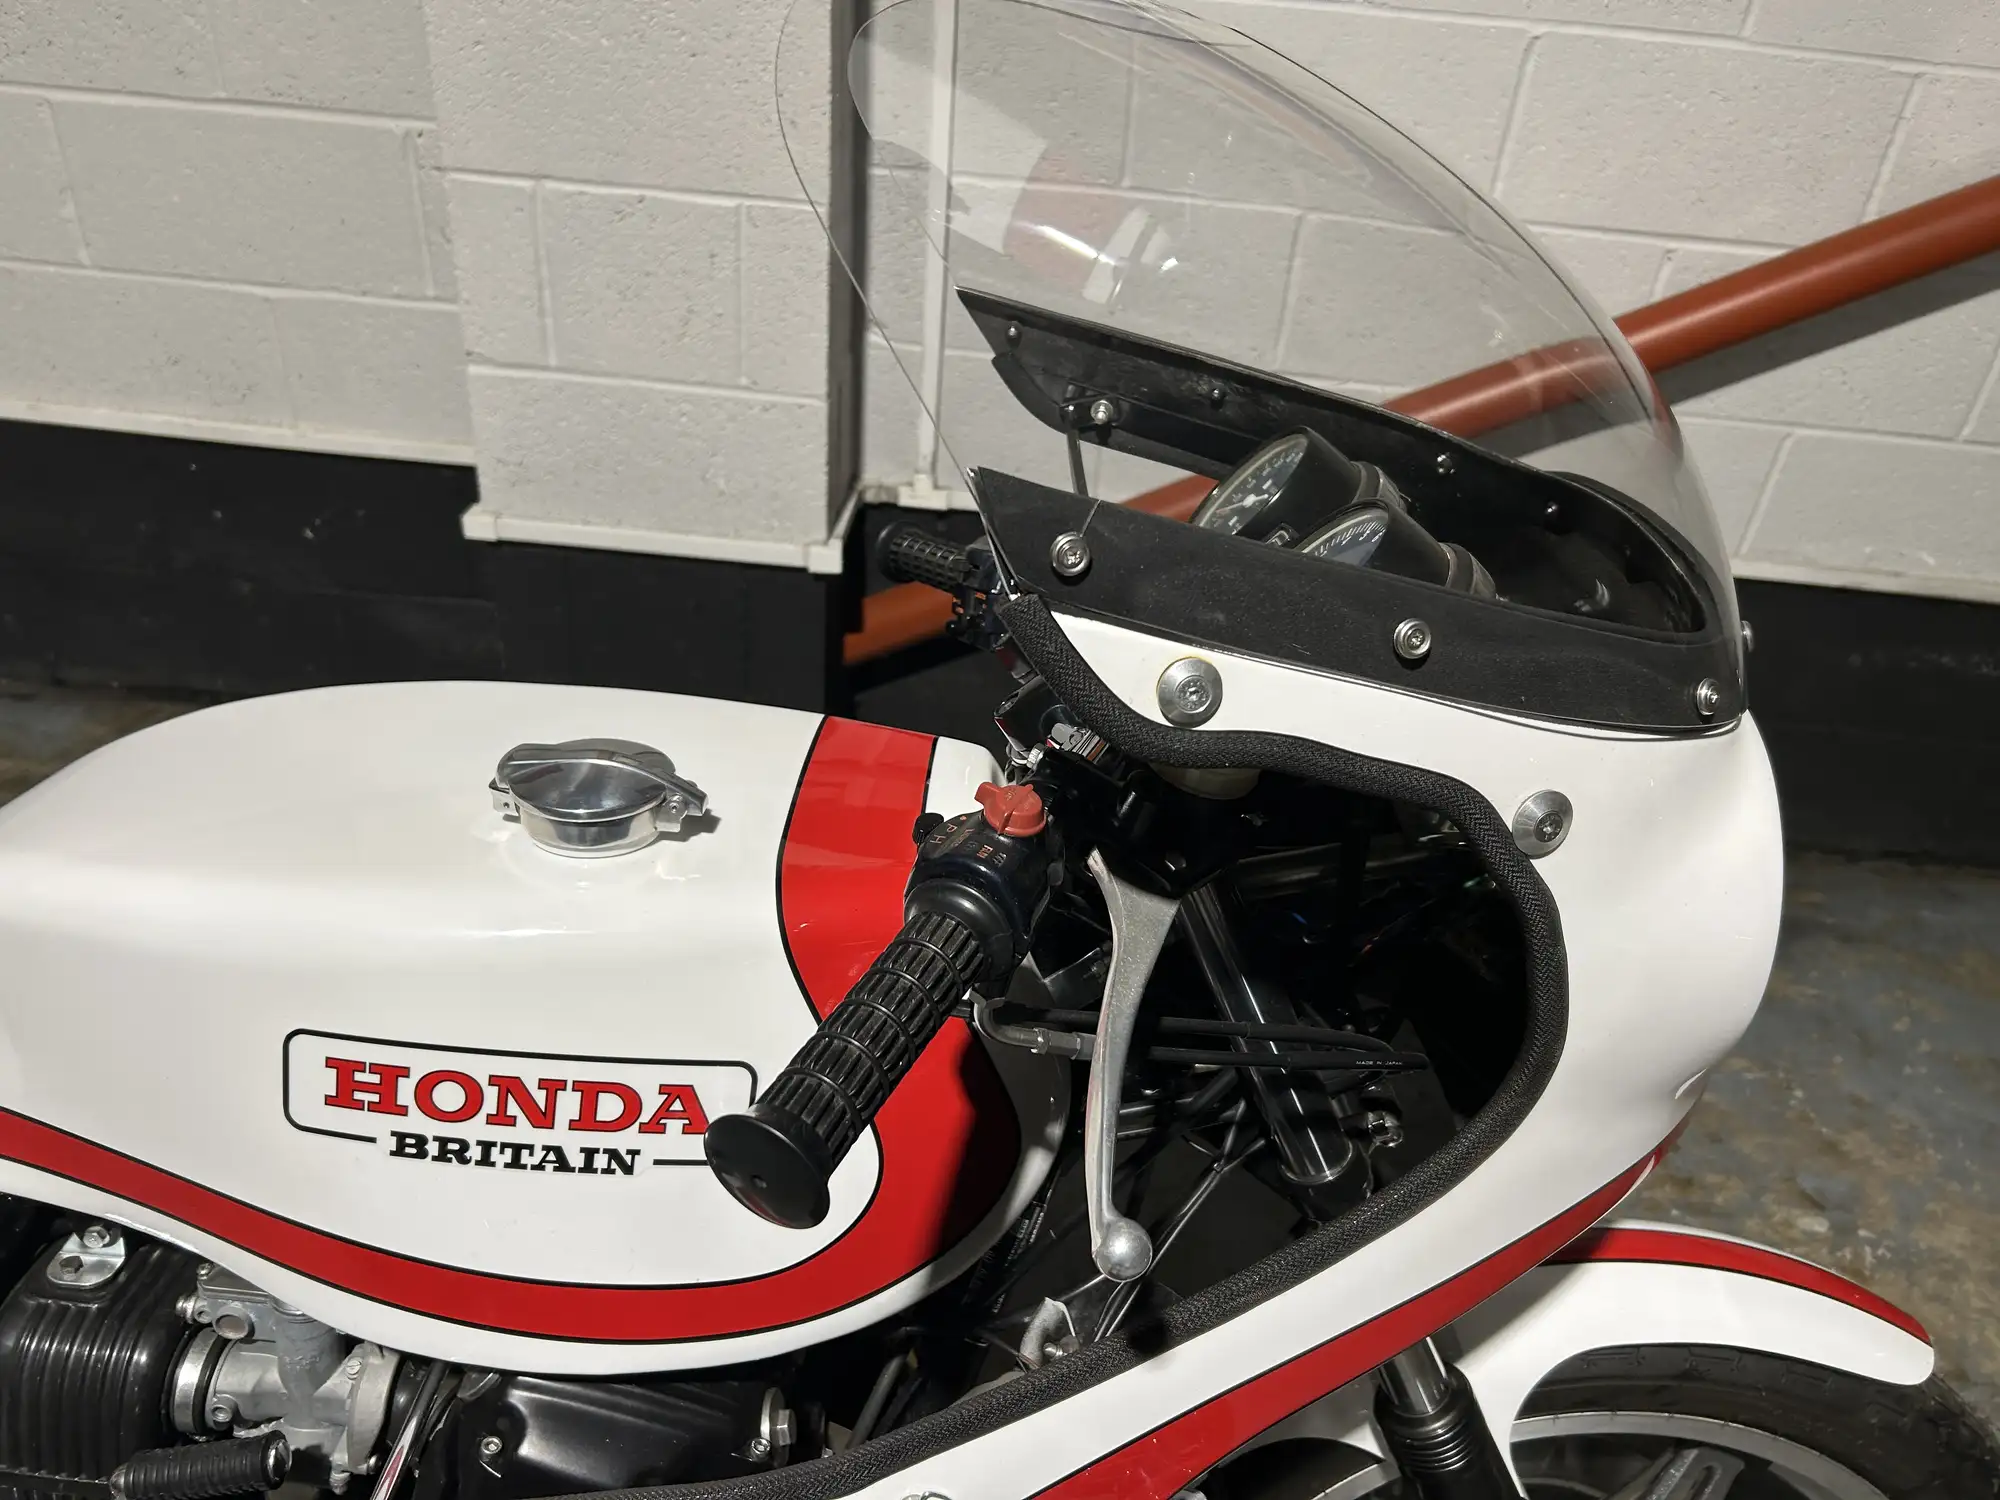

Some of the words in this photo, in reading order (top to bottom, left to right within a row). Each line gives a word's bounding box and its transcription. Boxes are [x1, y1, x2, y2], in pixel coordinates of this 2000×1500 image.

[930, 834, 946, 844] H
[946, 823, 958, 833] P
[324, 1056, 709, 1135] HONDA
[389, 1130, 641, 1176] BRITAIN
